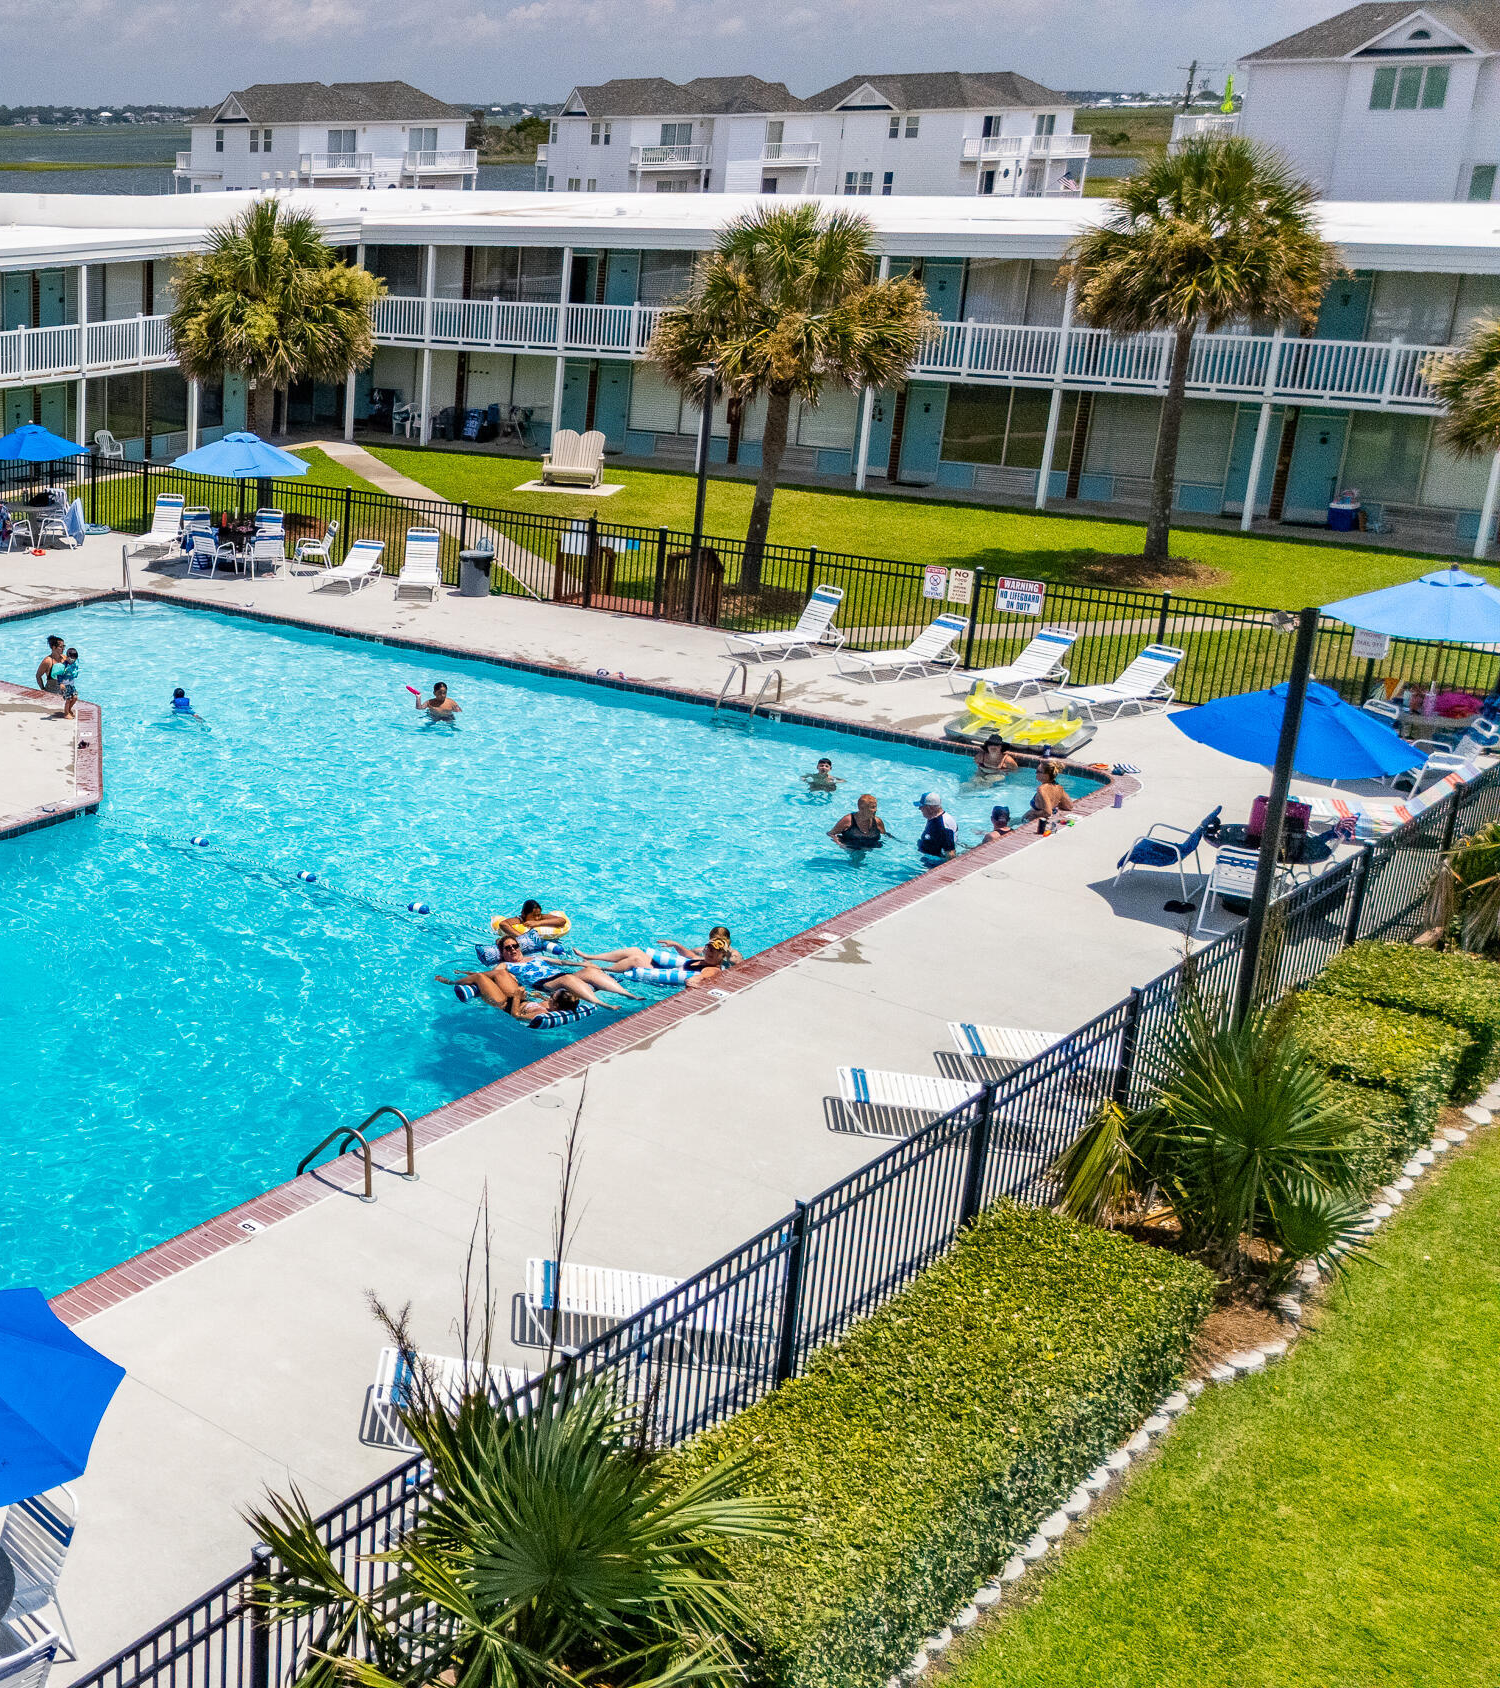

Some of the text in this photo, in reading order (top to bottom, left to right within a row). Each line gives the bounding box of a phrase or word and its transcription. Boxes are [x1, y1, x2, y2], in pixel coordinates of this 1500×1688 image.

[1004, 580, 1039, 592] WARNING
[1000, 590, 1039, 603] NO LIFEGUARD
[1006, 600, 1031, 611] ON DUTY
